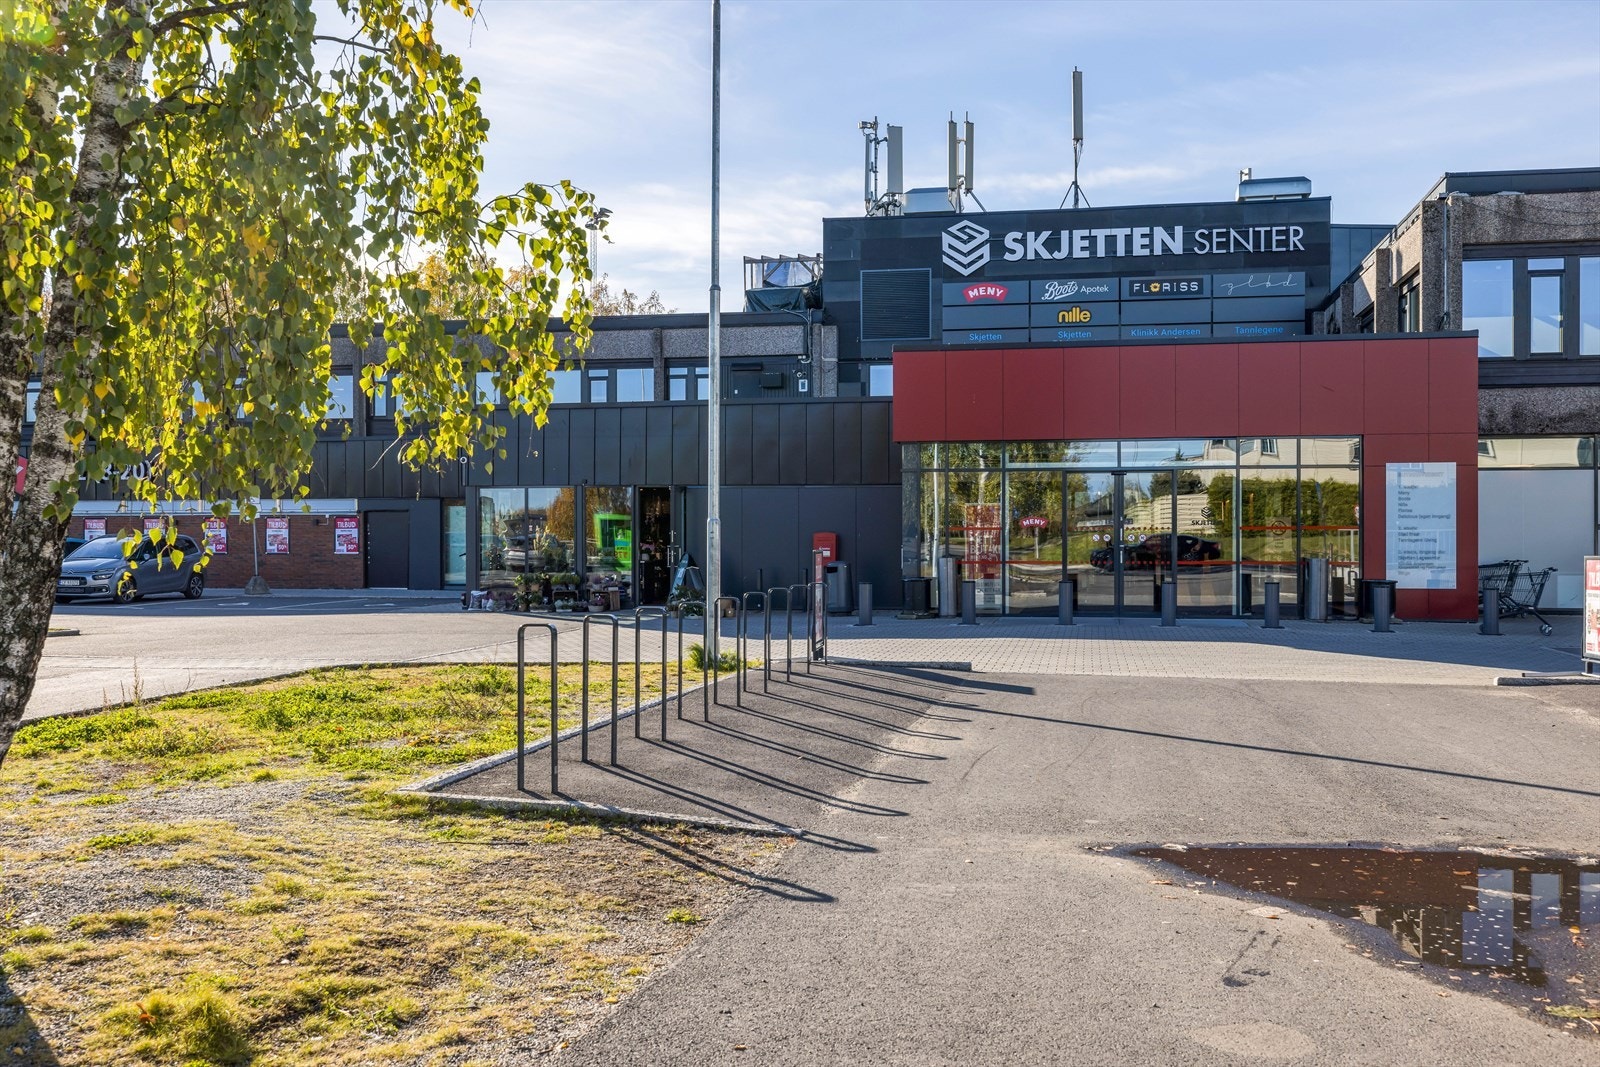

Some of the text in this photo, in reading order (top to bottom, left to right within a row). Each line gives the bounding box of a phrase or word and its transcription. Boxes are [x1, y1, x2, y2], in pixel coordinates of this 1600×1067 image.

[1003, 226, 1305, 262] SKJETTEN SENTER
[967, 286, 1004, 298] MENY
[1041, 281, 1109, 300] Boots Apotek
[1058, 306, 1091, 324] nille
[1057, 330, 1092, 339] Skjetten
[1131, 327, 1201, 337] Klinikk Andersen
[1234, 325, 1284, 336] Tannlegene
[969, 333, 1002, 342] Skjetten
[268, 521, 287, 529] TILBUD
[337, 521, 356, 529] TILBUD
[1022, 518, 1046, 527] MENY
